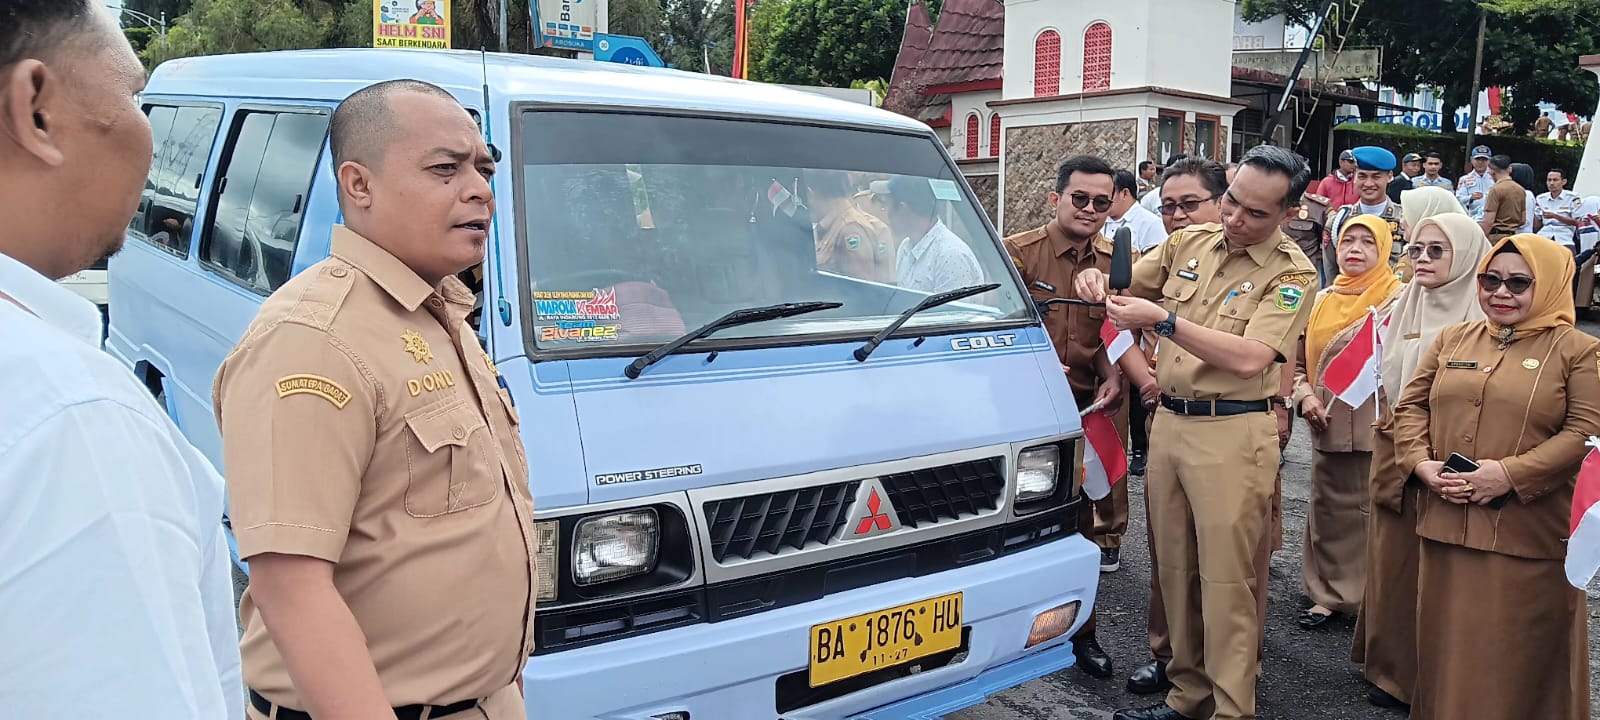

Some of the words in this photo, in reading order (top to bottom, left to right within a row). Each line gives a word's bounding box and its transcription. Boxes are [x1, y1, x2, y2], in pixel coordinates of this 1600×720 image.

[378, 23, 417, 38] HELM
[422, 26, 445, 39] SNI
[377, 37, 397, 46] SAAT
[399, 39, 447, 49] BERKENDARA
[950, 334, 1016, 351] COLT
[280, 379, 323, 392] SUMATERA
[323, 384, 347, 402] BARAT
[596, 471, 642, 485] POWER
[644, 464, 702, 480] STEERING
[817, 624, 845, 664] BA
[865, 608, 916, 651] 1876
[932, 597, 960, 634] HU
